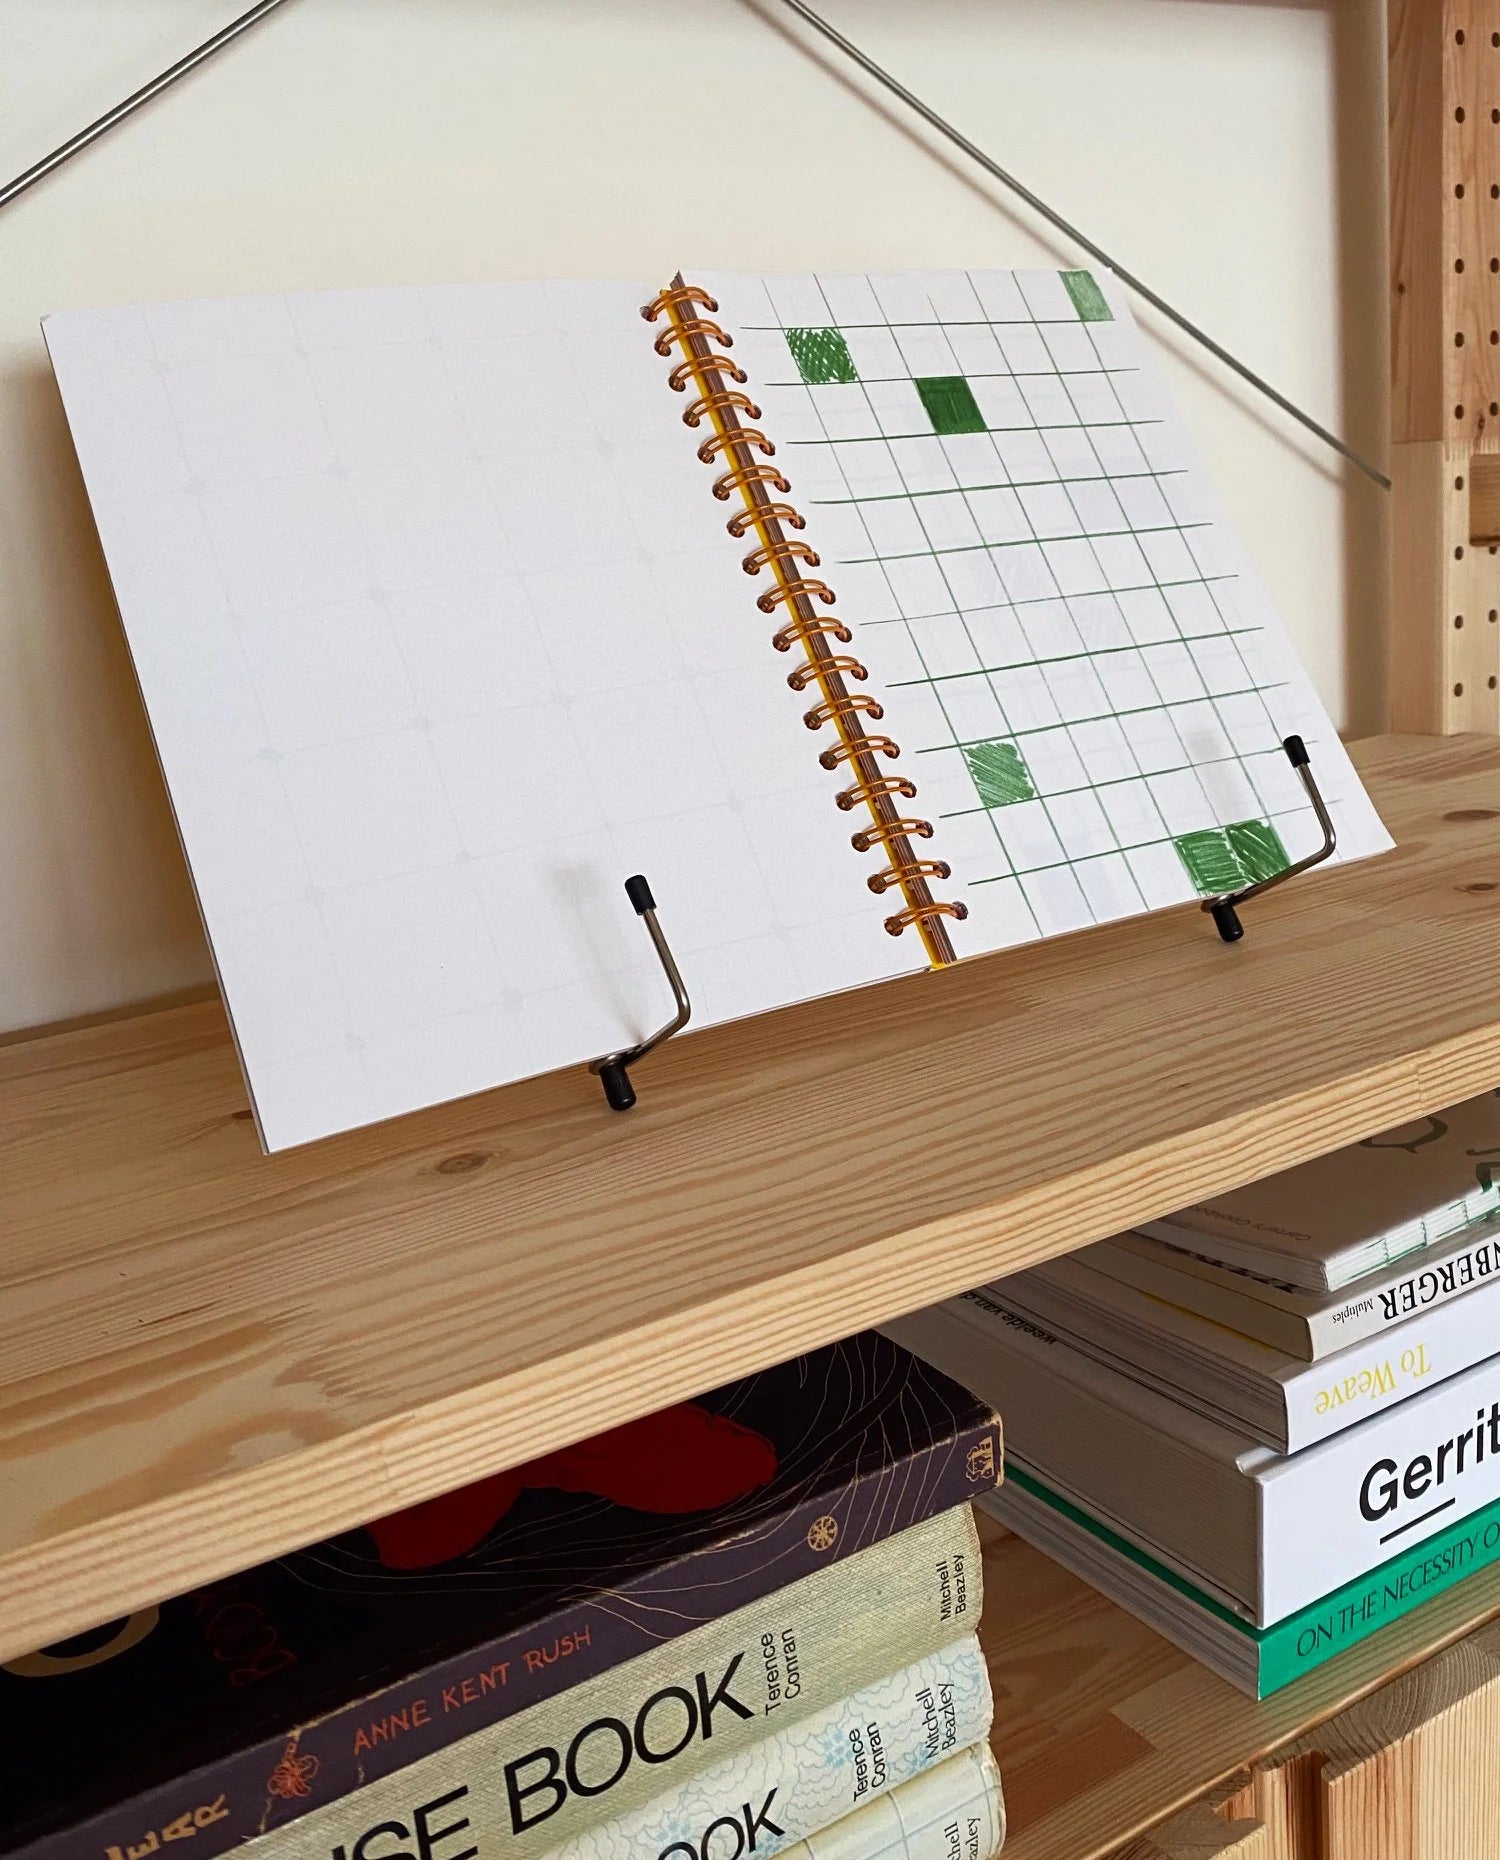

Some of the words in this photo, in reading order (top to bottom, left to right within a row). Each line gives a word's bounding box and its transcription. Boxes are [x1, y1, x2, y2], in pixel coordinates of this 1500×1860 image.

[1333, 1299, 1375, 1324] Multiples
[1315, 1360, 1397, 1415] Weave
[1401, 1343, 1432, 1378] To
[1359, 1402, 1500, 1522] Gerrit
[935, 1561, 951, 1620] Mitchell
[953, 1554, 966, 1614] Beazley
[1297, 1616, 1333, 1656] ON
[1339, 1590, 1377, 1633] THE
[1383, 1532, 1479, 1609] NECESSITY
[353, 1700, 432, 1756] ANNE
[441, 1661, 511, 1722] KENT
[523, 1624, 592, 1673] RUSH
[761, 1633, 781, 1716] Terence
[781, 1628, 801, 1699] Conran
[504, 1651, 755, 1835] BOOK
[915, 1688, 939, 1759] Mitchell
[938, 1684, 955, 1750] Beazley
[849, 1728, 868, 1801] Terence
[867, 1722, 886, 1788] Conran
